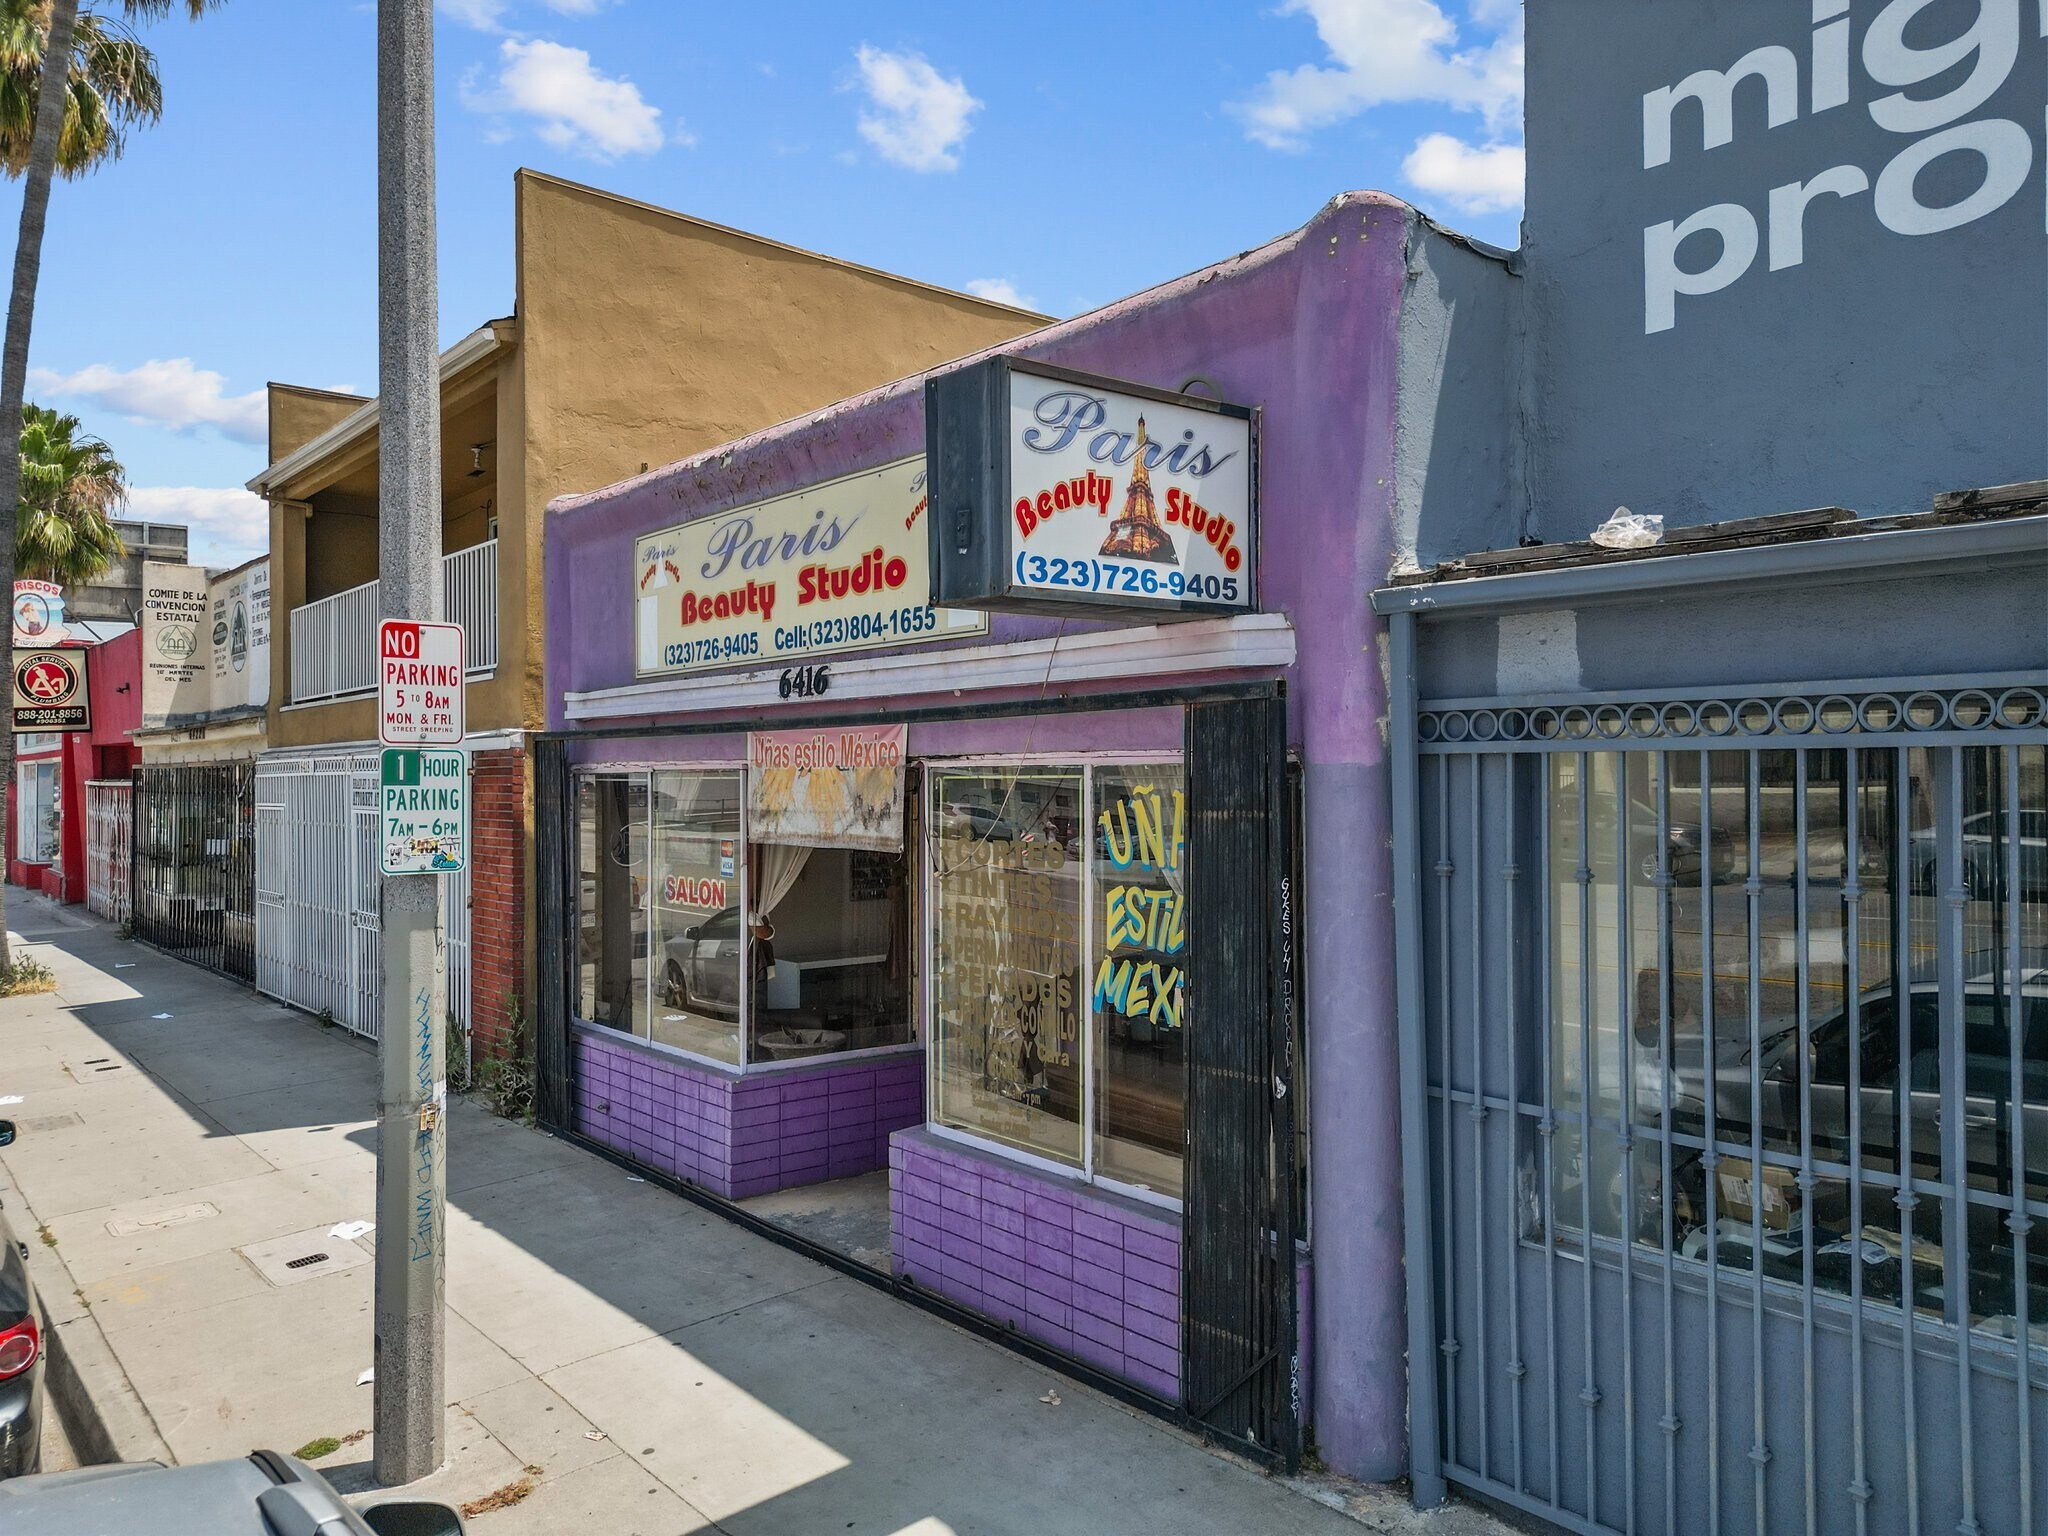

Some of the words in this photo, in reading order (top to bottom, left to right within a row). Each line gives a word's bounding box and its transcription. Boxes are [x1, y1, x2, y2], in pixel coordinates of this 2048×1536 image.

[1643, 0, 2048, 169] mig
[1644, 105, 2048, 335] pro
[1022, 390, 1239, 478] Paris
[905, 495, 928, 531] Beaut
[1014, 469, 1113, 542] Beauty
[1165, 487, 1242, 572] Studio
[642, 544, 679, 563] Paris
[700, 504, 869, 579] Paris
[13, 581, 59, 595] RISCOS
[640, 564, 657, 590] Beauty
[664, 559, 680, 583] Studio
[680, 579, 776, 627] Beauty
[797, 545, 908, 606] Studio
[1016, 551, 1239, 601] (323)726-9405
[145, 600, 206, 612] CONVENCION
[149, 588, 179, 599] COMITE
[182, 591, 194, 600] DE
[197, 592, 208, 601] LA
[156, 612, 200, 623] ESTATAL
[167, 637, 186, 650] AA
[385, 630, 416, 656] NO
[664, 631, 759, 667] (323)726-9405
[22, 658, 40, 671] TOTAL
[41, 656, 69, 670] SERVICE
[387, 663, 458, 687] PARKING
[779, 665, 831, 699] 6416
[30, 692, 69, 704] PLUMBING
[396, 690, 405, 708] 5
[411, 694, 421, 703] TO
[425, 691, 450, 709] 8AM
[17, 709, 83, 720] 888-201-8856
[386, 713, 415, 724] MON.
[420, 714, 429, 725] &
[433, 714, 454, 726] FRI.
[754, 736, 791, 770] Uñas
[793, 734, 836, 770] estilo
[839, 732, 900, 769] México
[398, 755, 405, 781] 1
[423, 759, 459, 778] HOUR
[386, 789, 459, 811] PARKING
[388, 818, 414, 836] 7AM
[432, 818, 458, 836] 6PM
[1098, 783, 1185, 871] UÑA
[955, 837, 1065, 871] CORTES
[665, 875, 726, 910] SALON
[957, 871, 1053, 903] TINTES
[955, 902, 1073, 940] RAYITOS
[954, 964, 1073, 1009] PEINADOS
